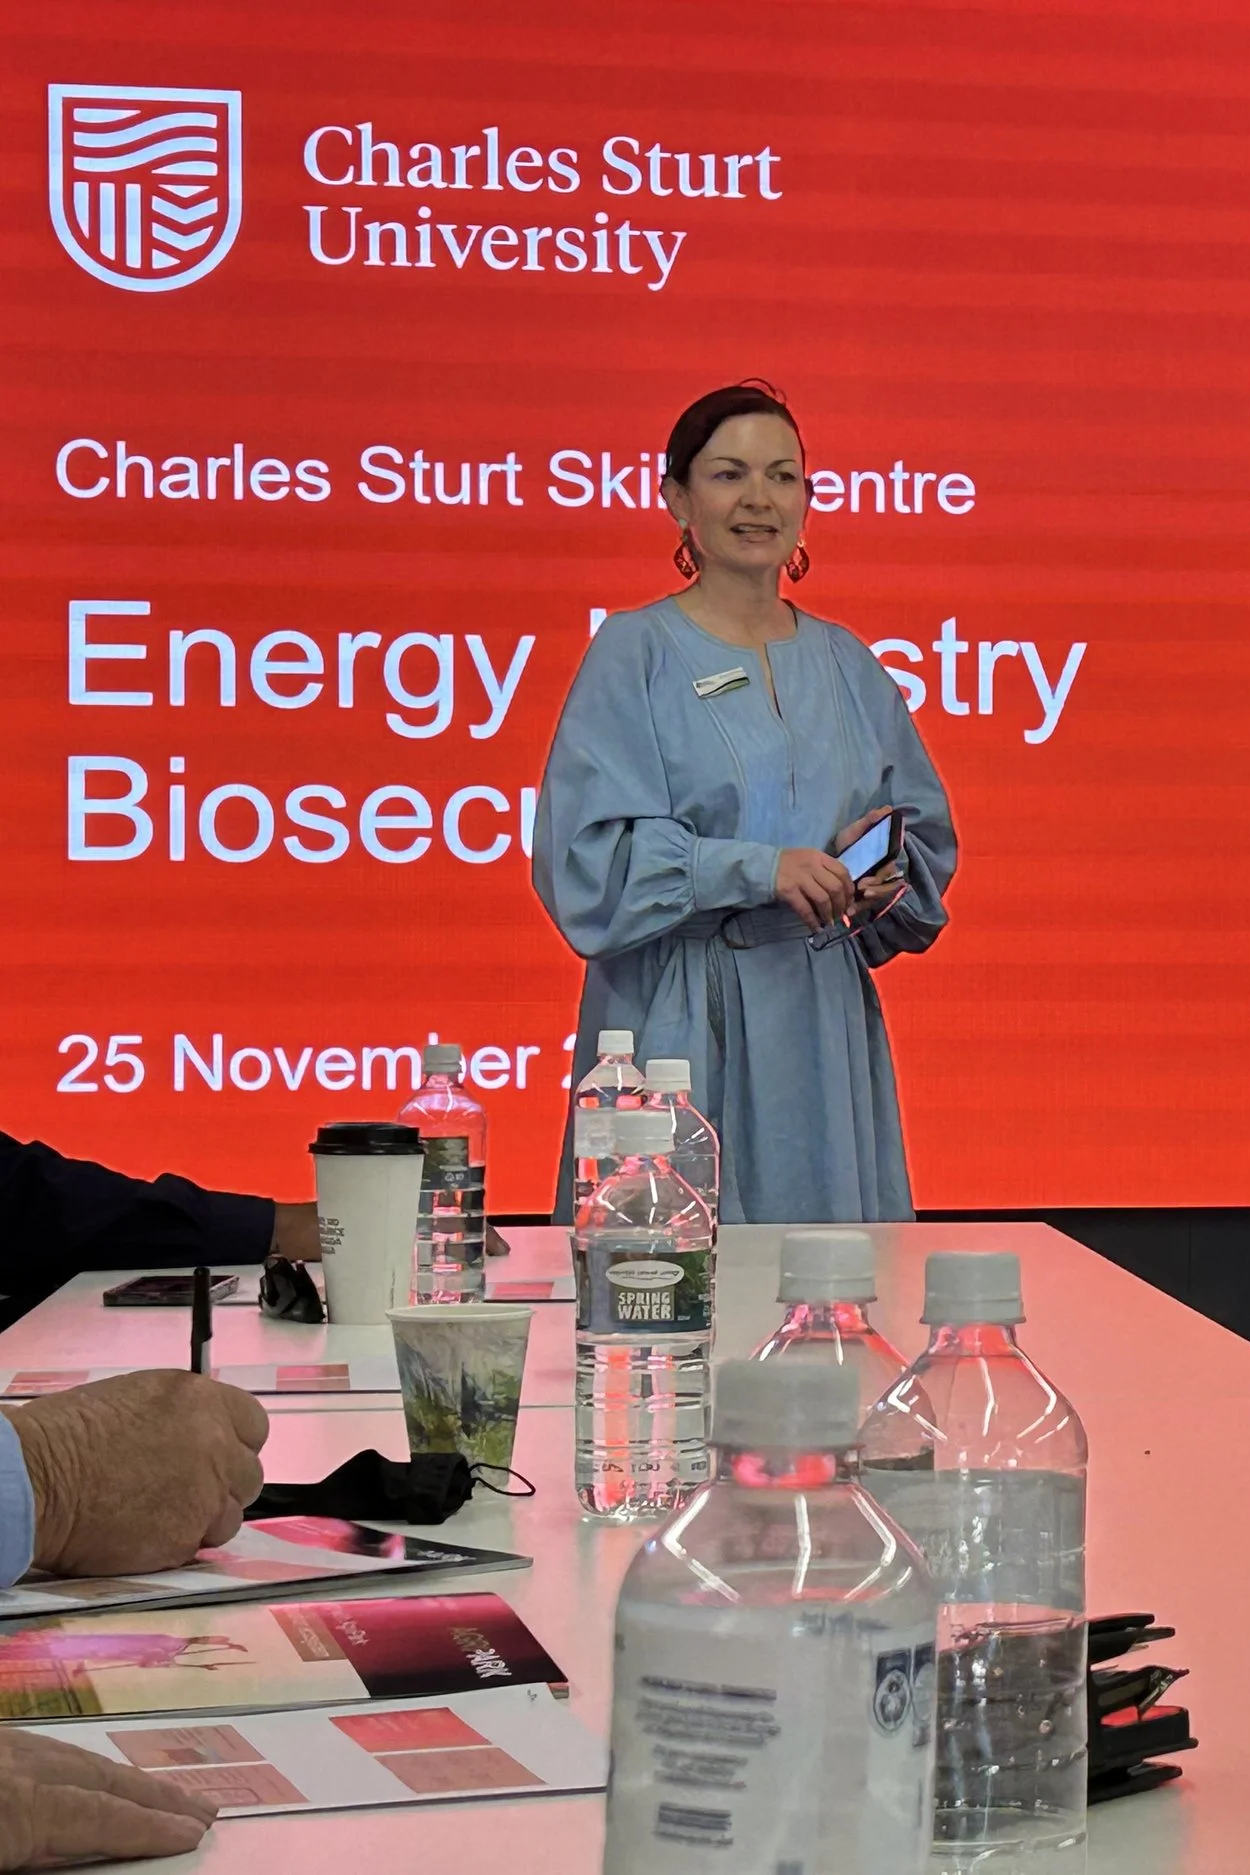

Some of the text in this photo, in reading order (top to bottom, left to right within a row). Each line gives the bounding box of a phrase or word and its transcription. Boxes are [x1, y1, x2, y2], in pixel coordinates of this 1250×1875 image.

[303, 121, 783, 201] Charles Sturt
[302, 205, 688, 292] University
[55, 438, 976, 515] Charles Sturt Skil entre
[68, 599, 537, 740] Energy
[67, 755, 536, 865] Biosec
[56, 1033, 146, 1094] 25
[618, 1292, 671, 1305] SPRING
[618, 1304, 672, 1320] WATER
